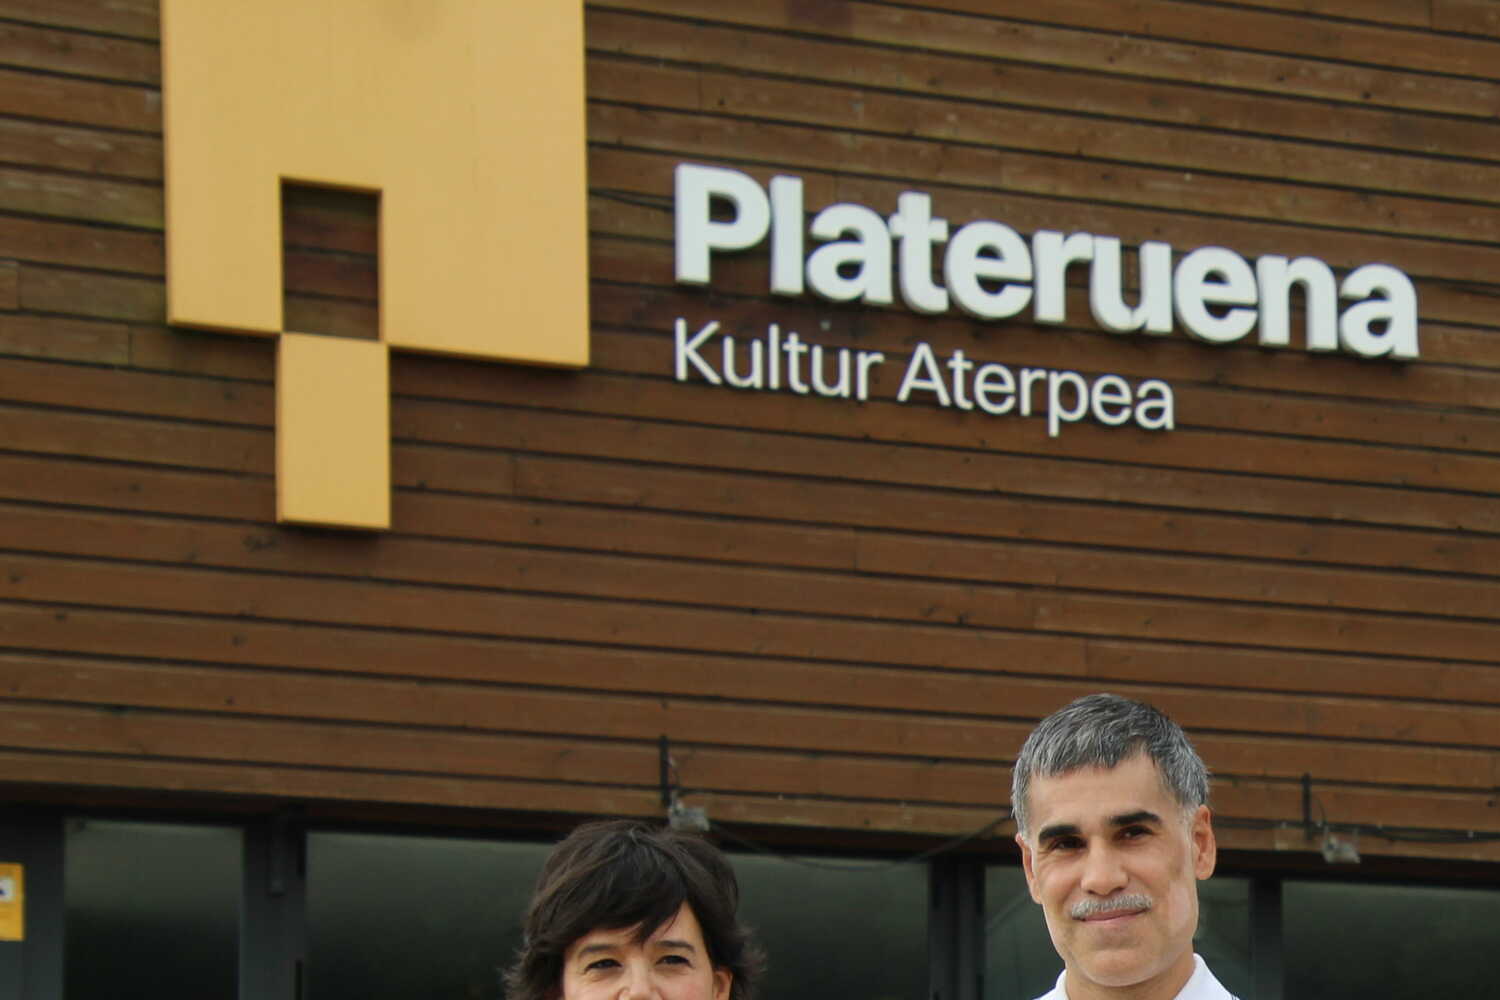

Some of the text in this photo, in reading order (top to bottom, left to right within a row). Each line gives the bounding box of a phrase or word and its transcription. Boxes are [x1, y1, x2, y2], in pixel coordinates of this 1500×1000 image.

[674, 162, 1419, 359] Plateruena
[674, 317, 1175, 437] Kultur Aterpea
